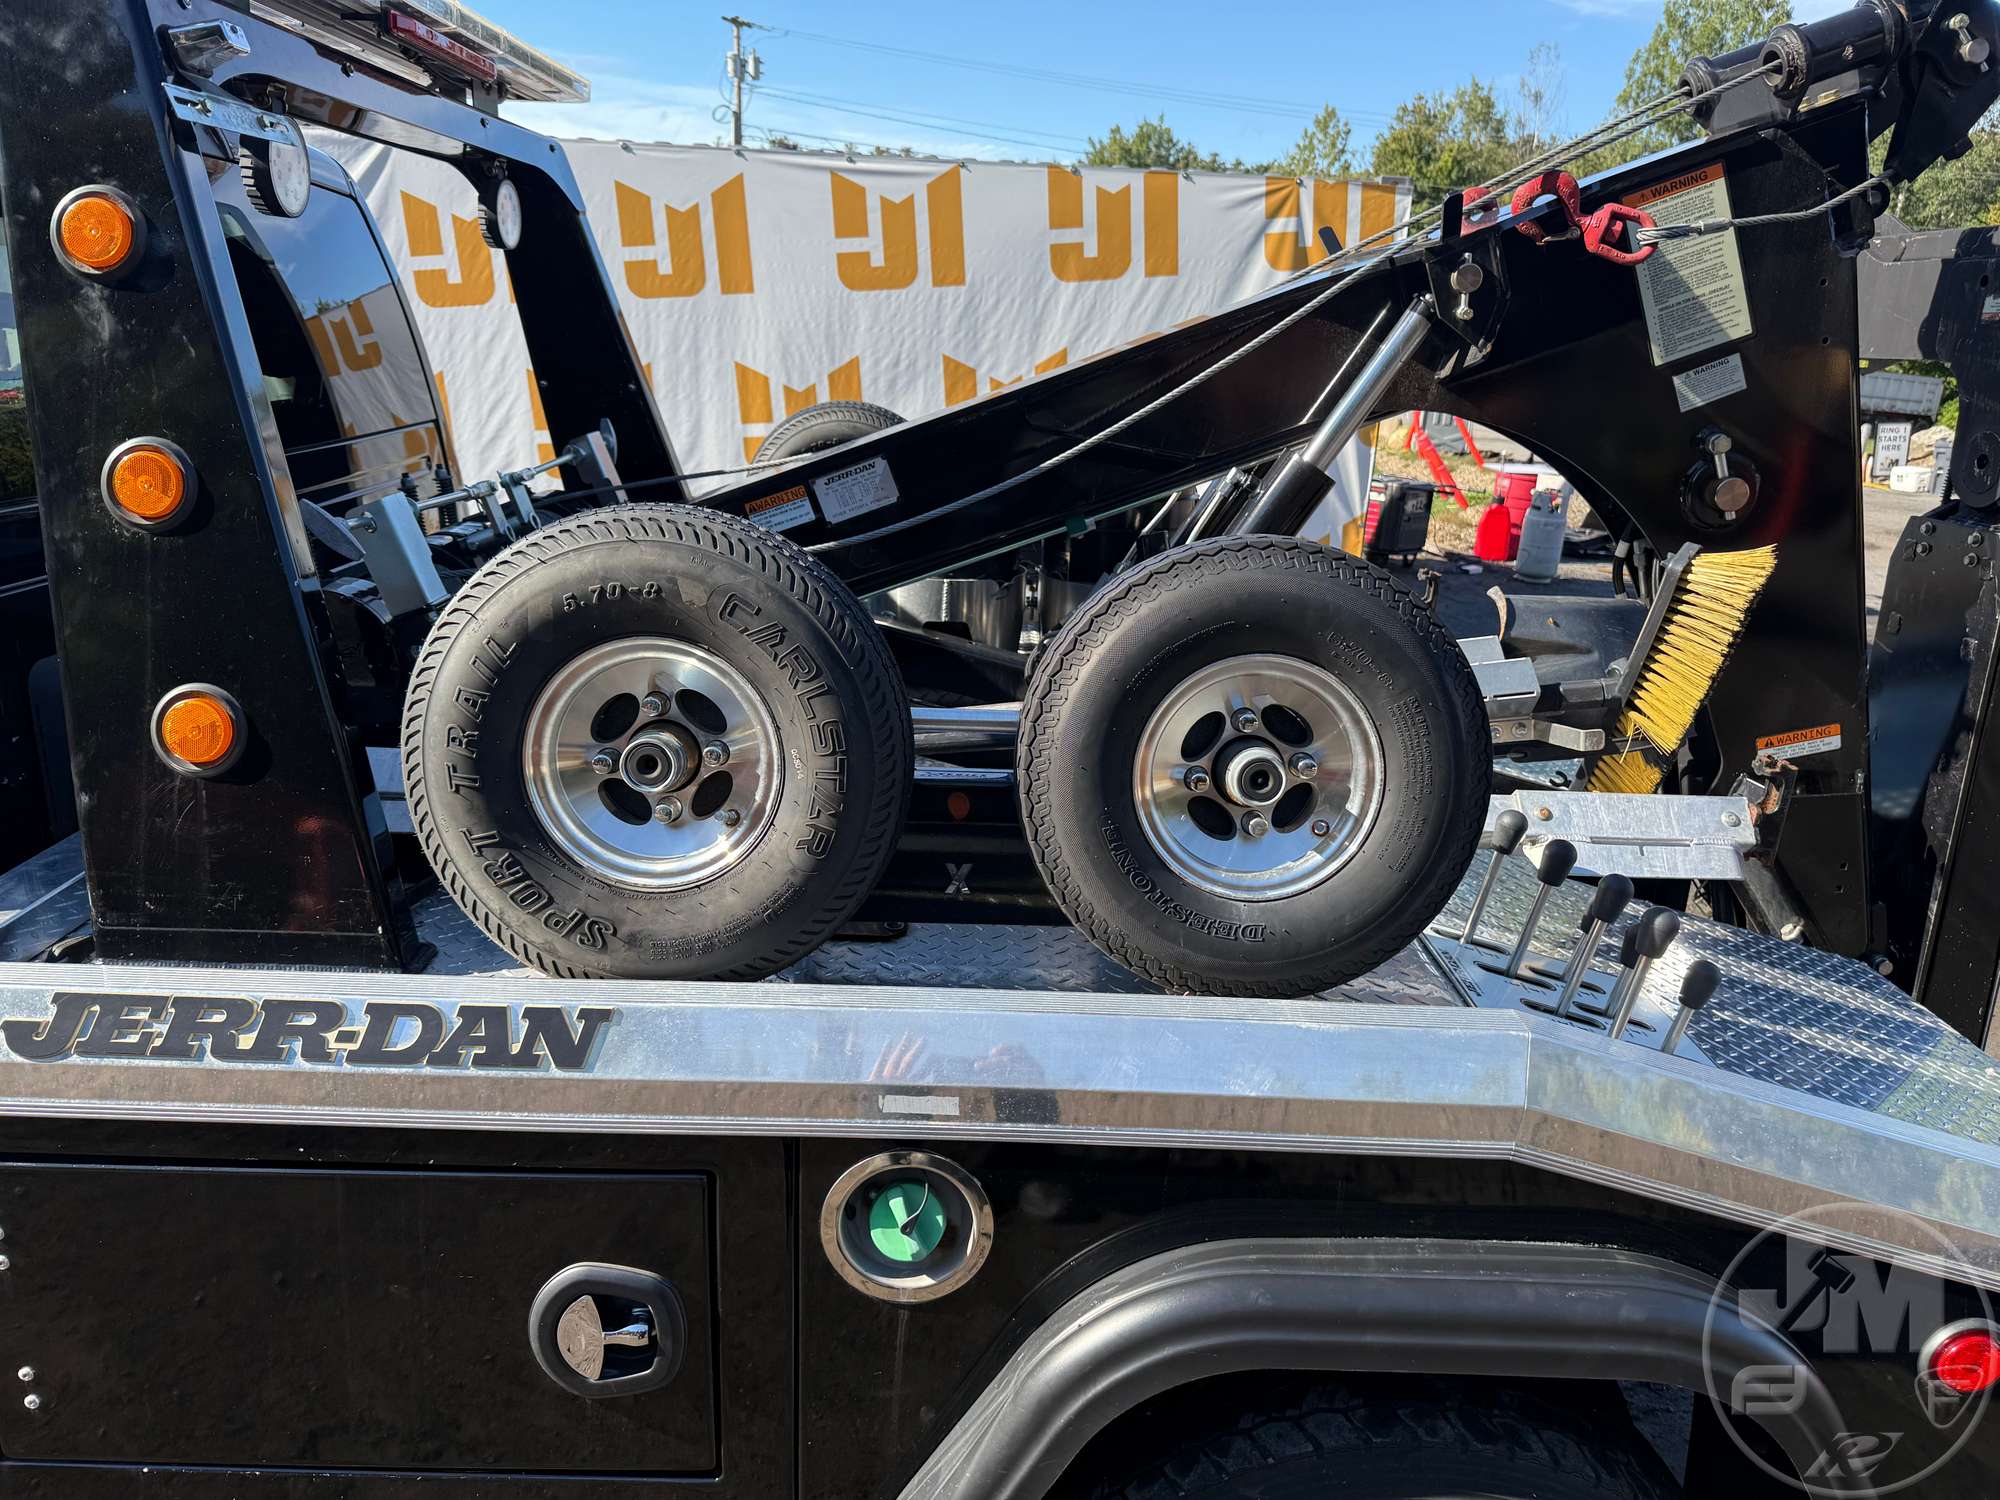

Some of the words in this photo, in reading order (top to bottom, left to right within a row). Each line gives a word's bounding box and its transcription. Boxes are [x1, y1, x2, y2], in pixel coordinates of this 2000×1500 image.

[1651, 170, 1709, 199] WARNING
[1693, 358, 1730, 376] WARNING
[1878, 435, 1907, 443] STARTS
[824, 461, 876, 486] JERR-DAN
[757, 486, 806, 513] WARNING
[446, 633, 519, 795] TRAIL
[717, 590, 848, 861] CARLSTAR
[1776, 727, 1831, 745] WARNING
[459, 826, 617, 952] SPORT
[1101, 825, 1266, 943] DEESTONE
[0, 992, 614, 1073] JERR-DAN
